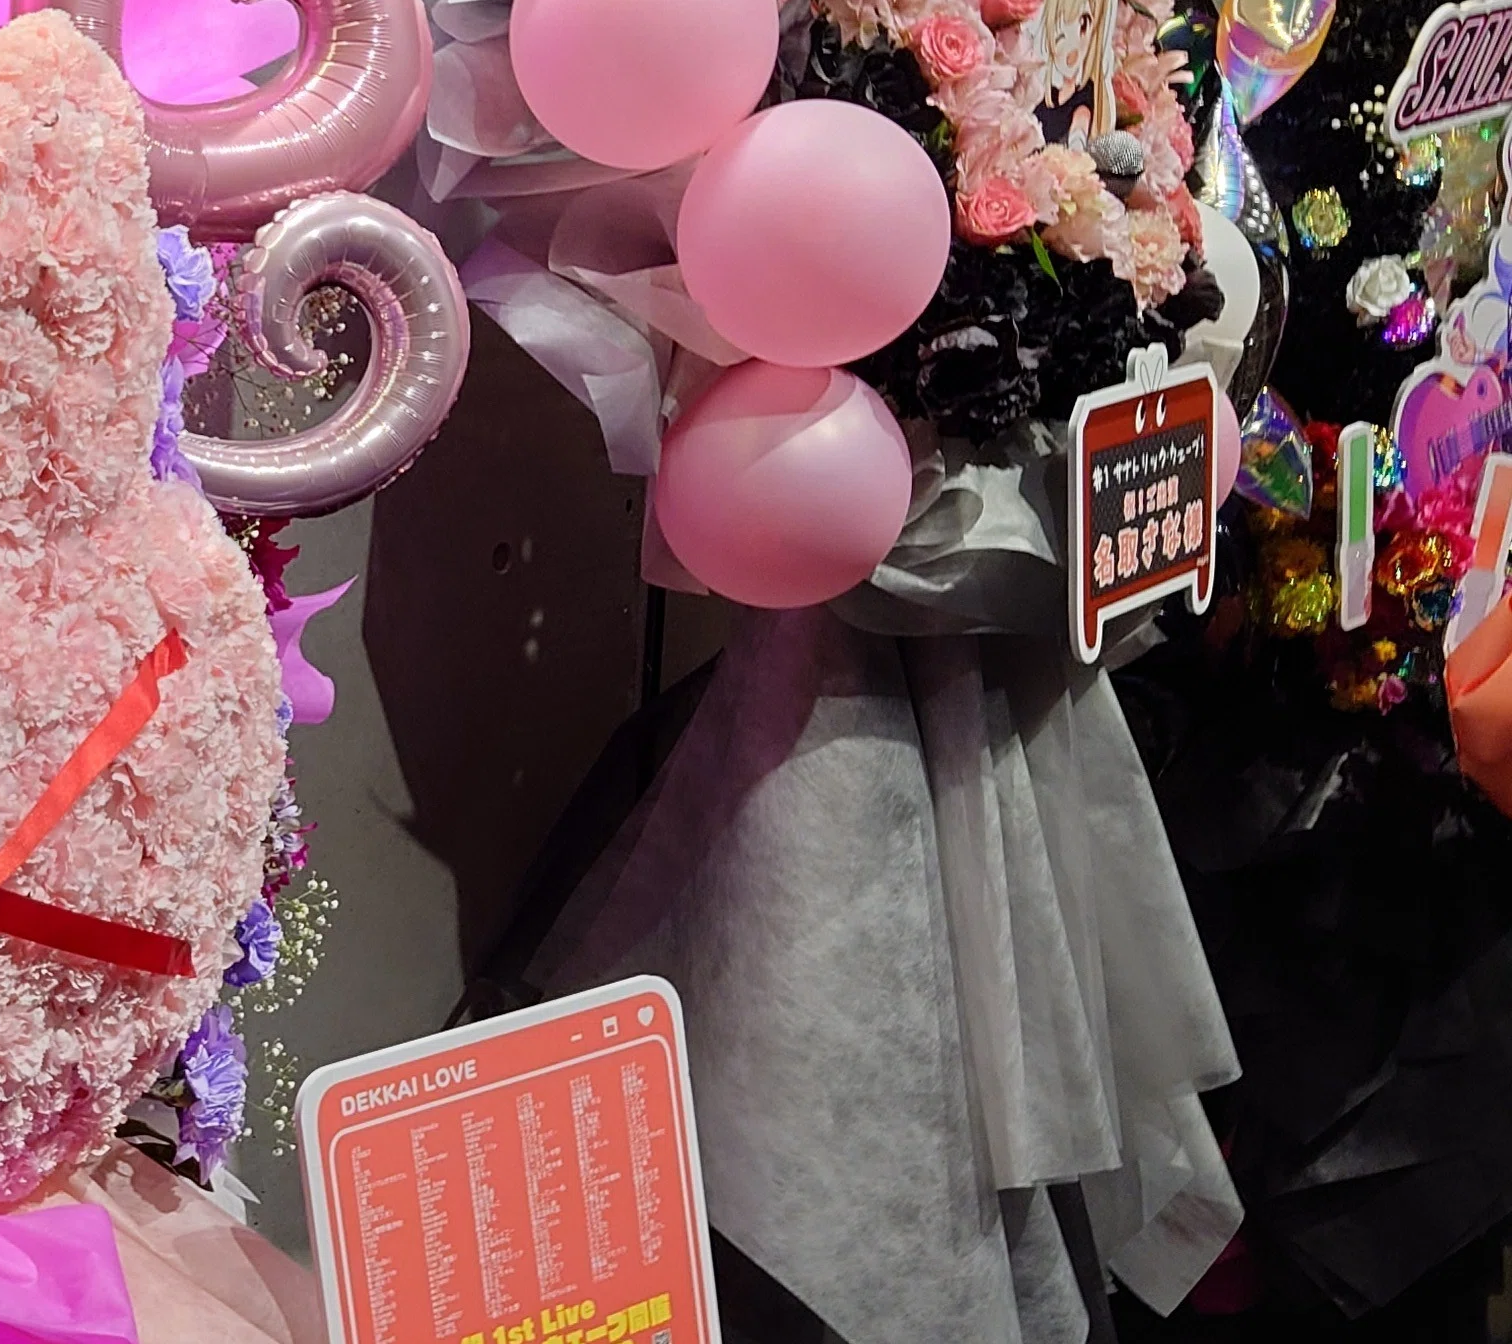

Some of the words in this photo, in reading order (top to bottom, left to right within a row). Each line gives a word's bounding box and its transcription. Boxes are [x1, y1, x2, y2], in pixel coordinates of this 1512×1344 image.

[1396, 6, 1512, 130] SANA
[1093, 498, 1204, 588] 名取さな様
[340, 1076, 419, 1117] DEKKAI
[422, 1058, 478, 1093] LOVE
[541, 1298, 596, 1335] Live
